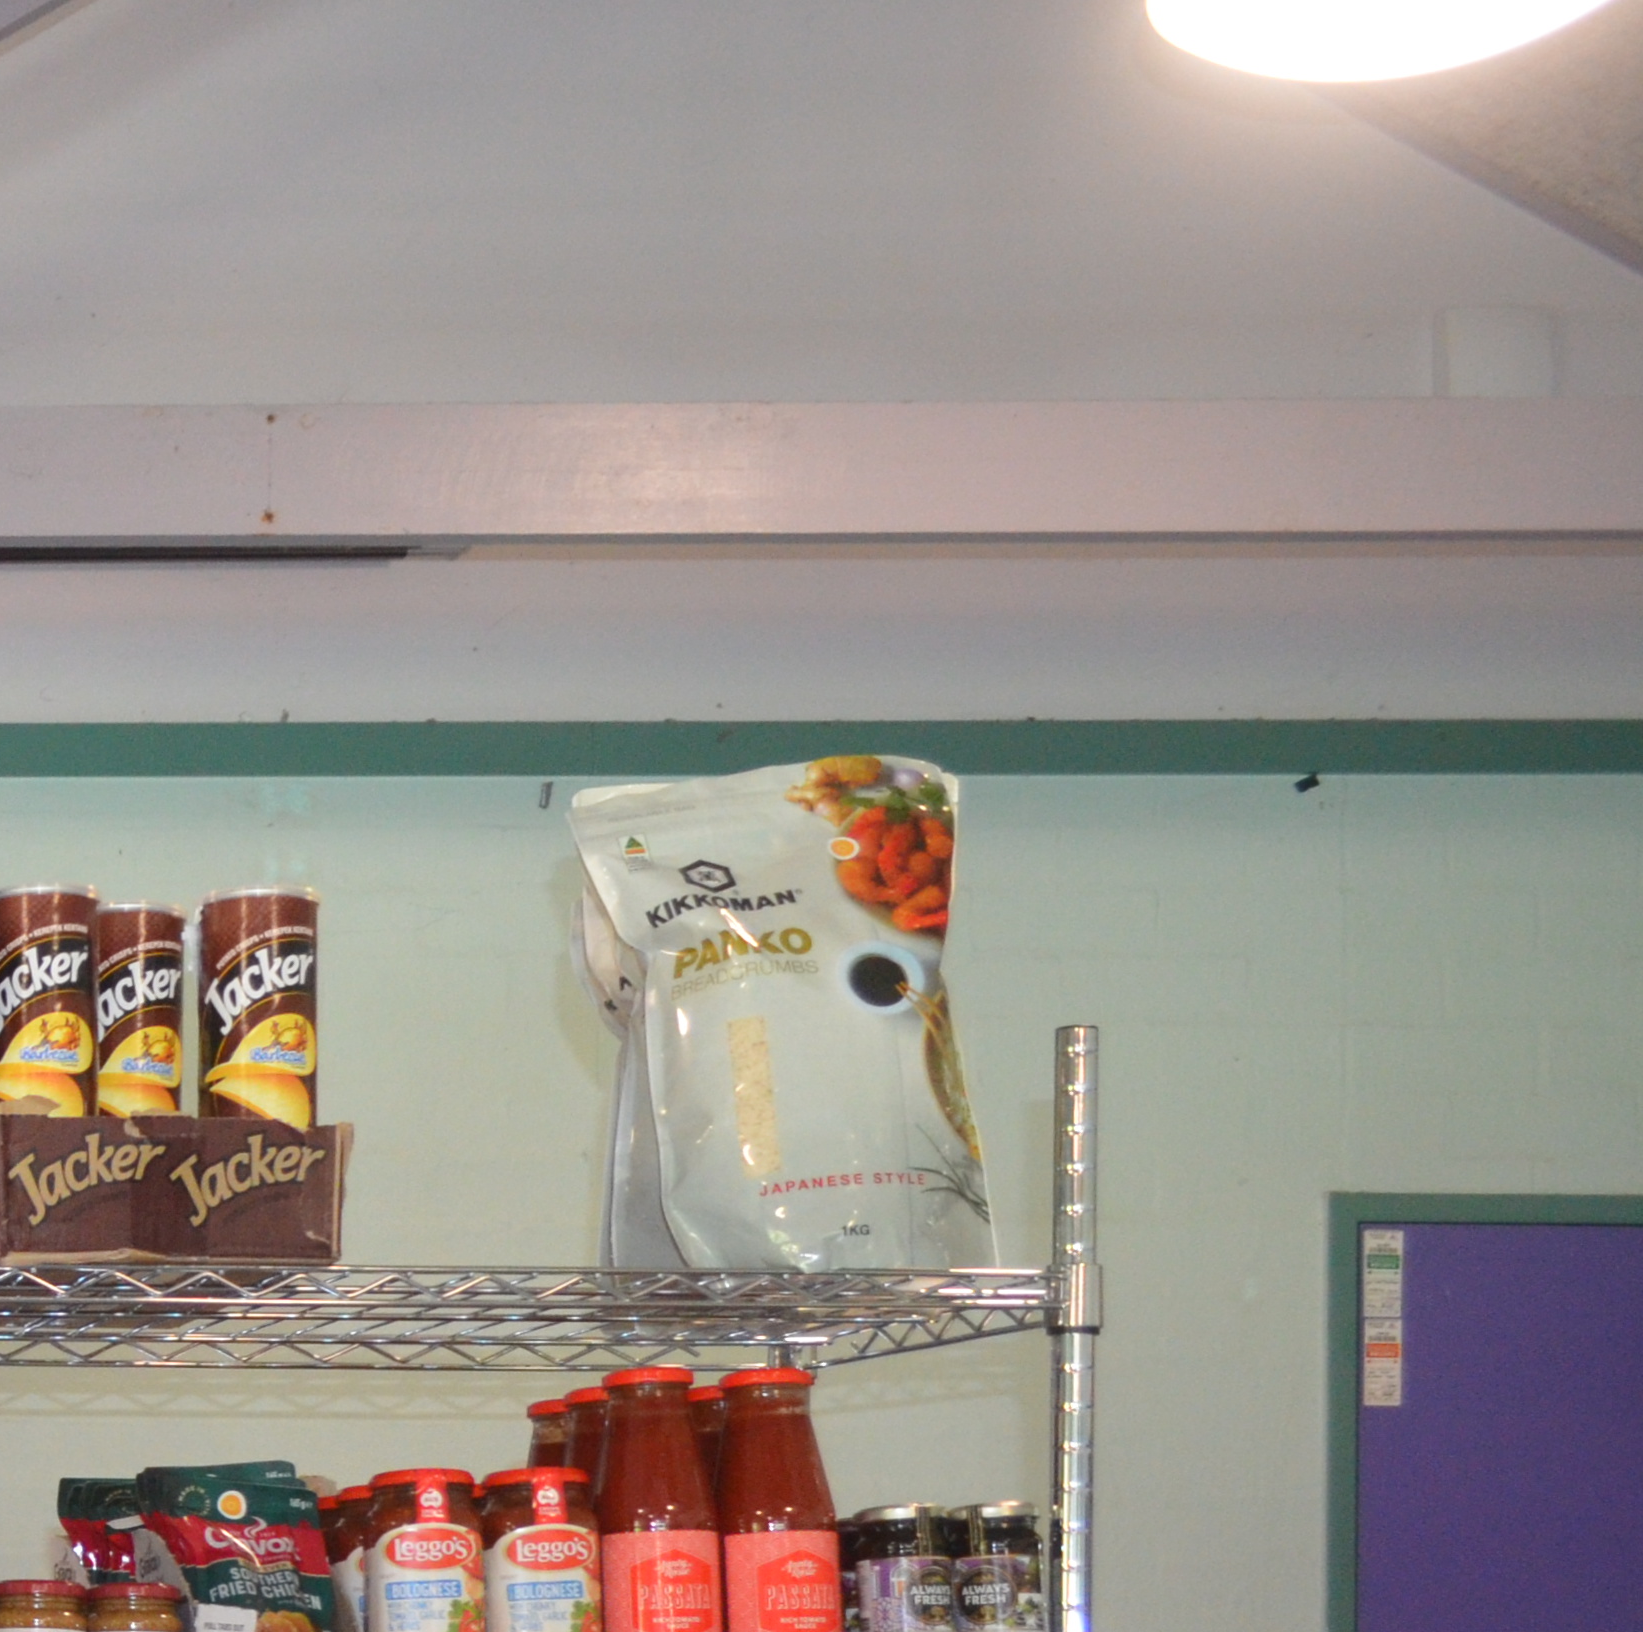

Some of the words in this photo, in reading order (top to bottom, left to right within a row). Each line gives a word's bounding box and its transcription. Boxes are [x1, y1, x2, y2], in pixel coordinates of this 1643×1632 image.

[645, 889, 798, 928] KIKKOMAN
[673, 927, 813, 979] PANKO
[204, 946, 314, 1036] Jacker
[670, 959, 820, 1000] BREADCRUMBS
[8, 1133, 166, 1226] Jacker
[759, 1172, 865, 1197] JAPANESE
[873, 1171, 926, 1185] STYLE
[394, 1536, 469, 1562] Leggo's
[516, 1537, 589, 1563] Leggo's
[392, 1582, 459, 1598] BOLOGNESE
[765, 1582, 836, 1611] PASSATA
[961, 1583, 1011, 1597] ALWAYS
[964, 1593, 1006, 1605] FRESH
